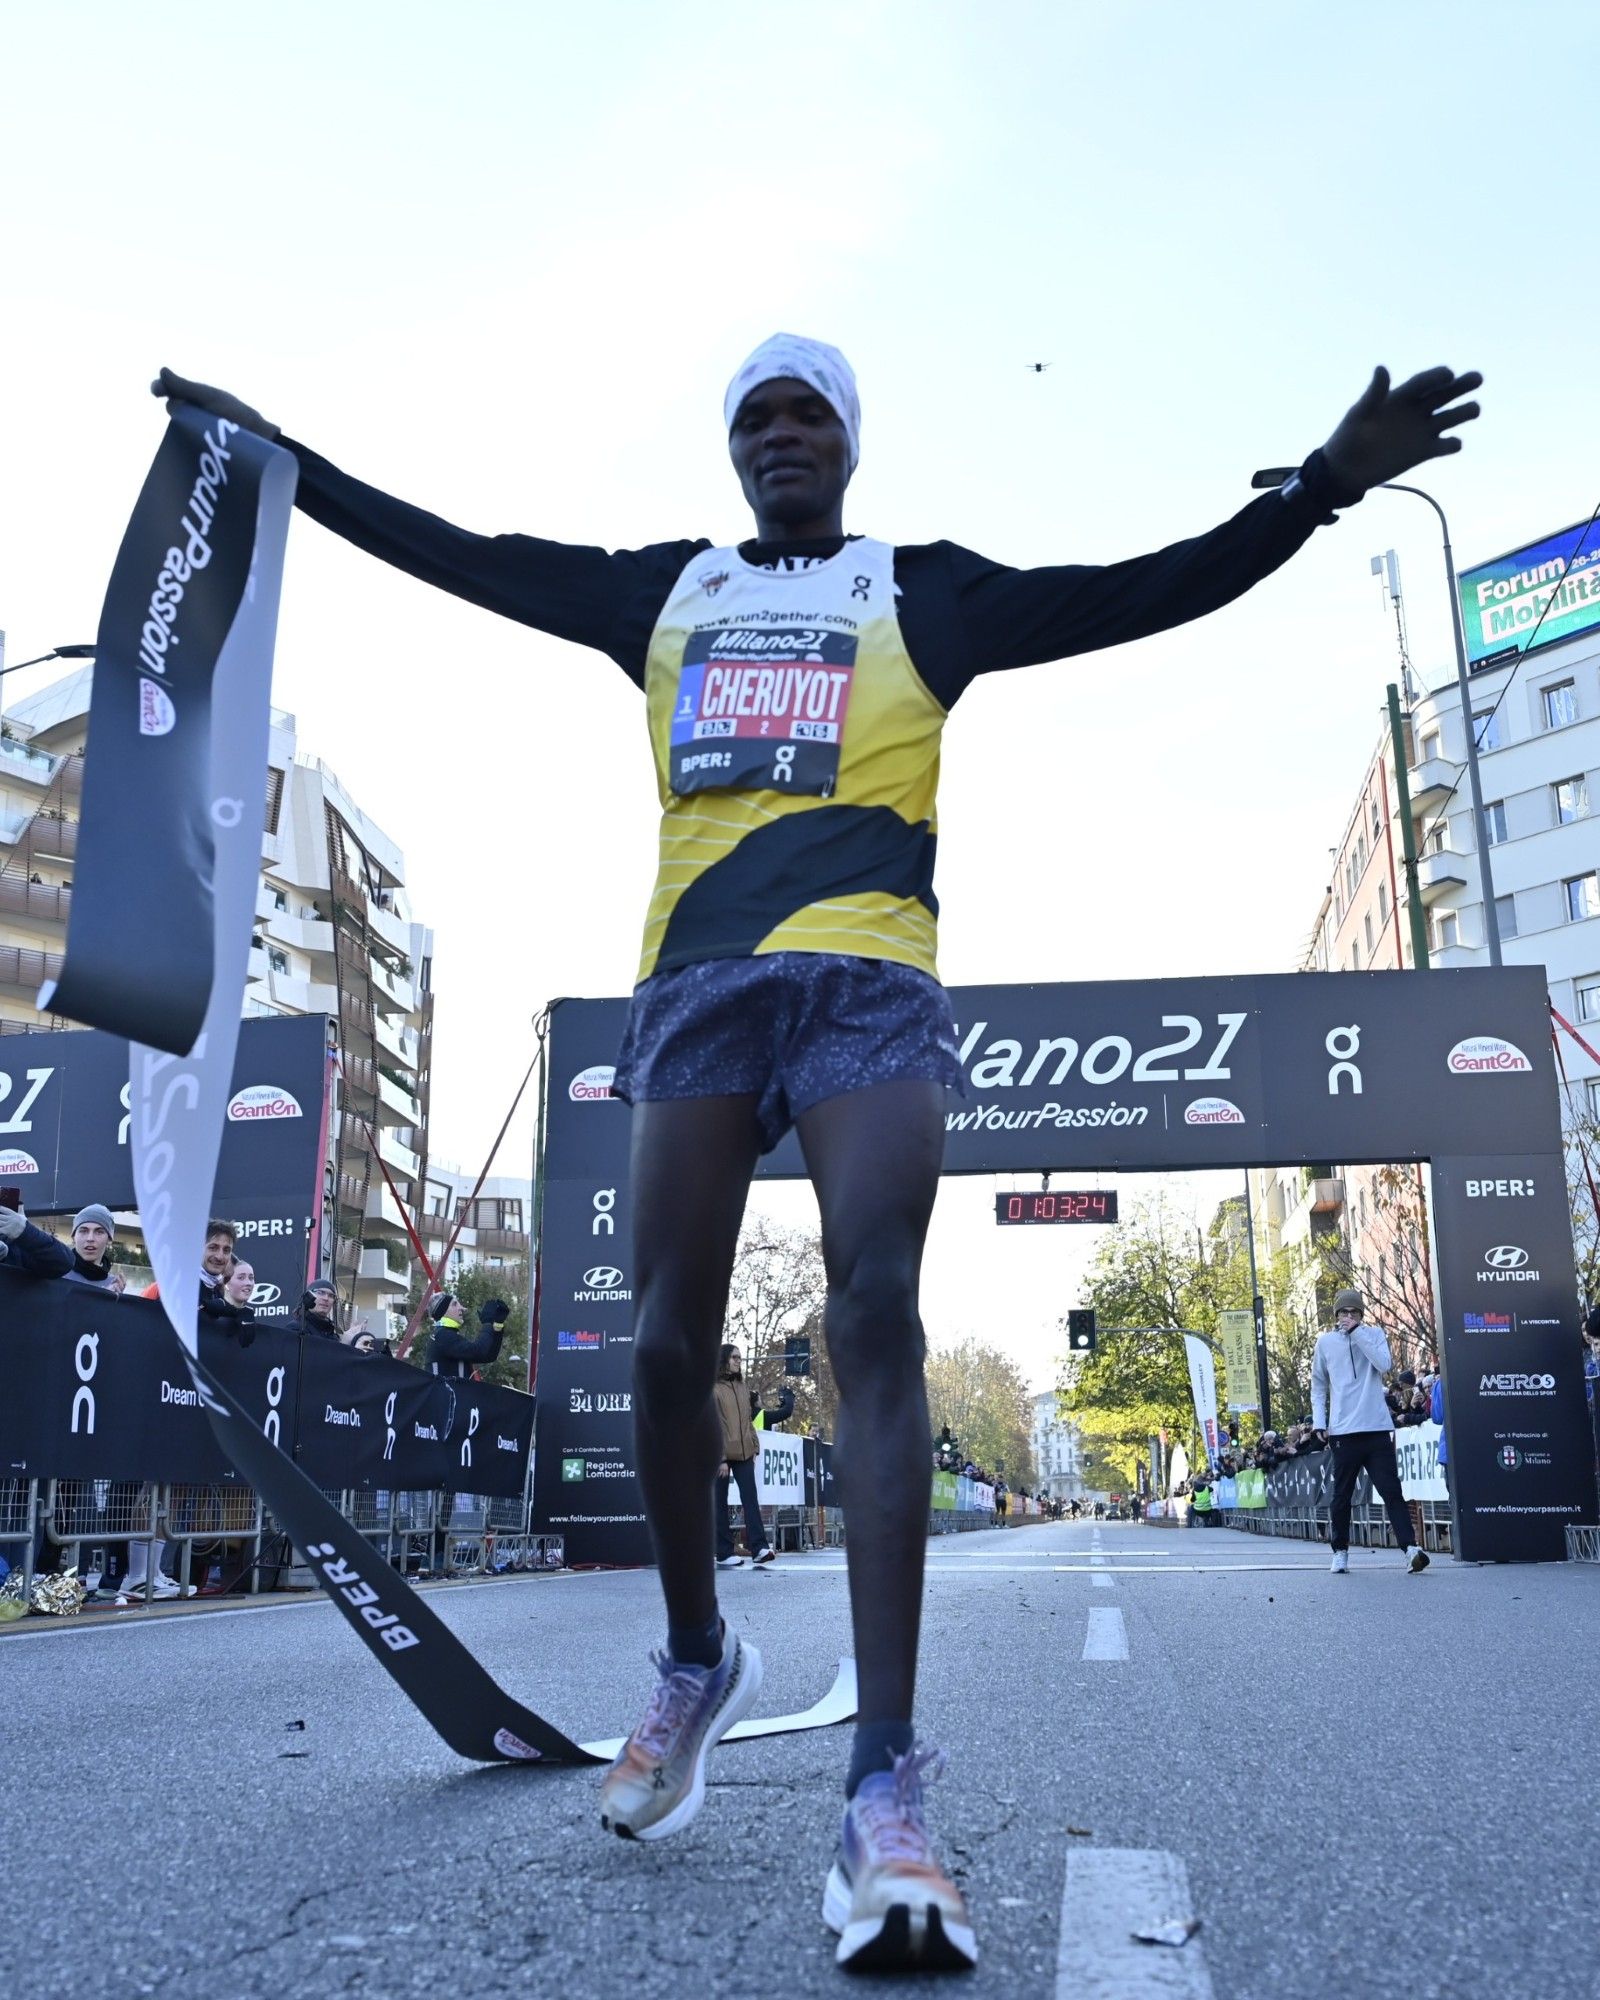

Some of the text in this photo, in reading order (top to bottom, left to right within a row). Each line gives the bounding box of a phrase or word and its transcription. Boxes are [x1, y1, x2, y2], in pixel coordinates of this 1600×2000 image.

[1477, 557, 1566, 607] Forum
[694, 609, 858, 631] www.run2gether.com
[711, 631, 829, 651] Milano21
[702, 667, 848, 720] CHERUYOT
[679, 696, 693, 715] 1
[760, 720, 770, 735] 2
[953, 1012, 1248, 1089] lano21
[945, 1101, 1149, 1131] wYourPassion
[1008, 1196, 1105, 1219] 01:03:24
[1477, 1271, 1540, 1282] HYUNDAI
[574, 1290, 632, 1301] HYUNDAI
[1464, 1312, 1511, 1327] BigMat
[558, 1331, 600, 1345] BigMat
[161, 1380, 197, 1407] Dream
[570, 1393, 632, 1412] 24 ORE
[324, 1404, 349, 1426] Dream
[414, 1421, 430, 1440] Dream
[586, 1462, 625, 1472] Regione
[1524, 1457, 1551, 1465] Milano
[586, 1469, 636, 1478] Lombardia
[548, 1514, 646, 1523] www.followyourpassion.it
[1475, 1505, 1582, 1514] www.followyourpassion.it
